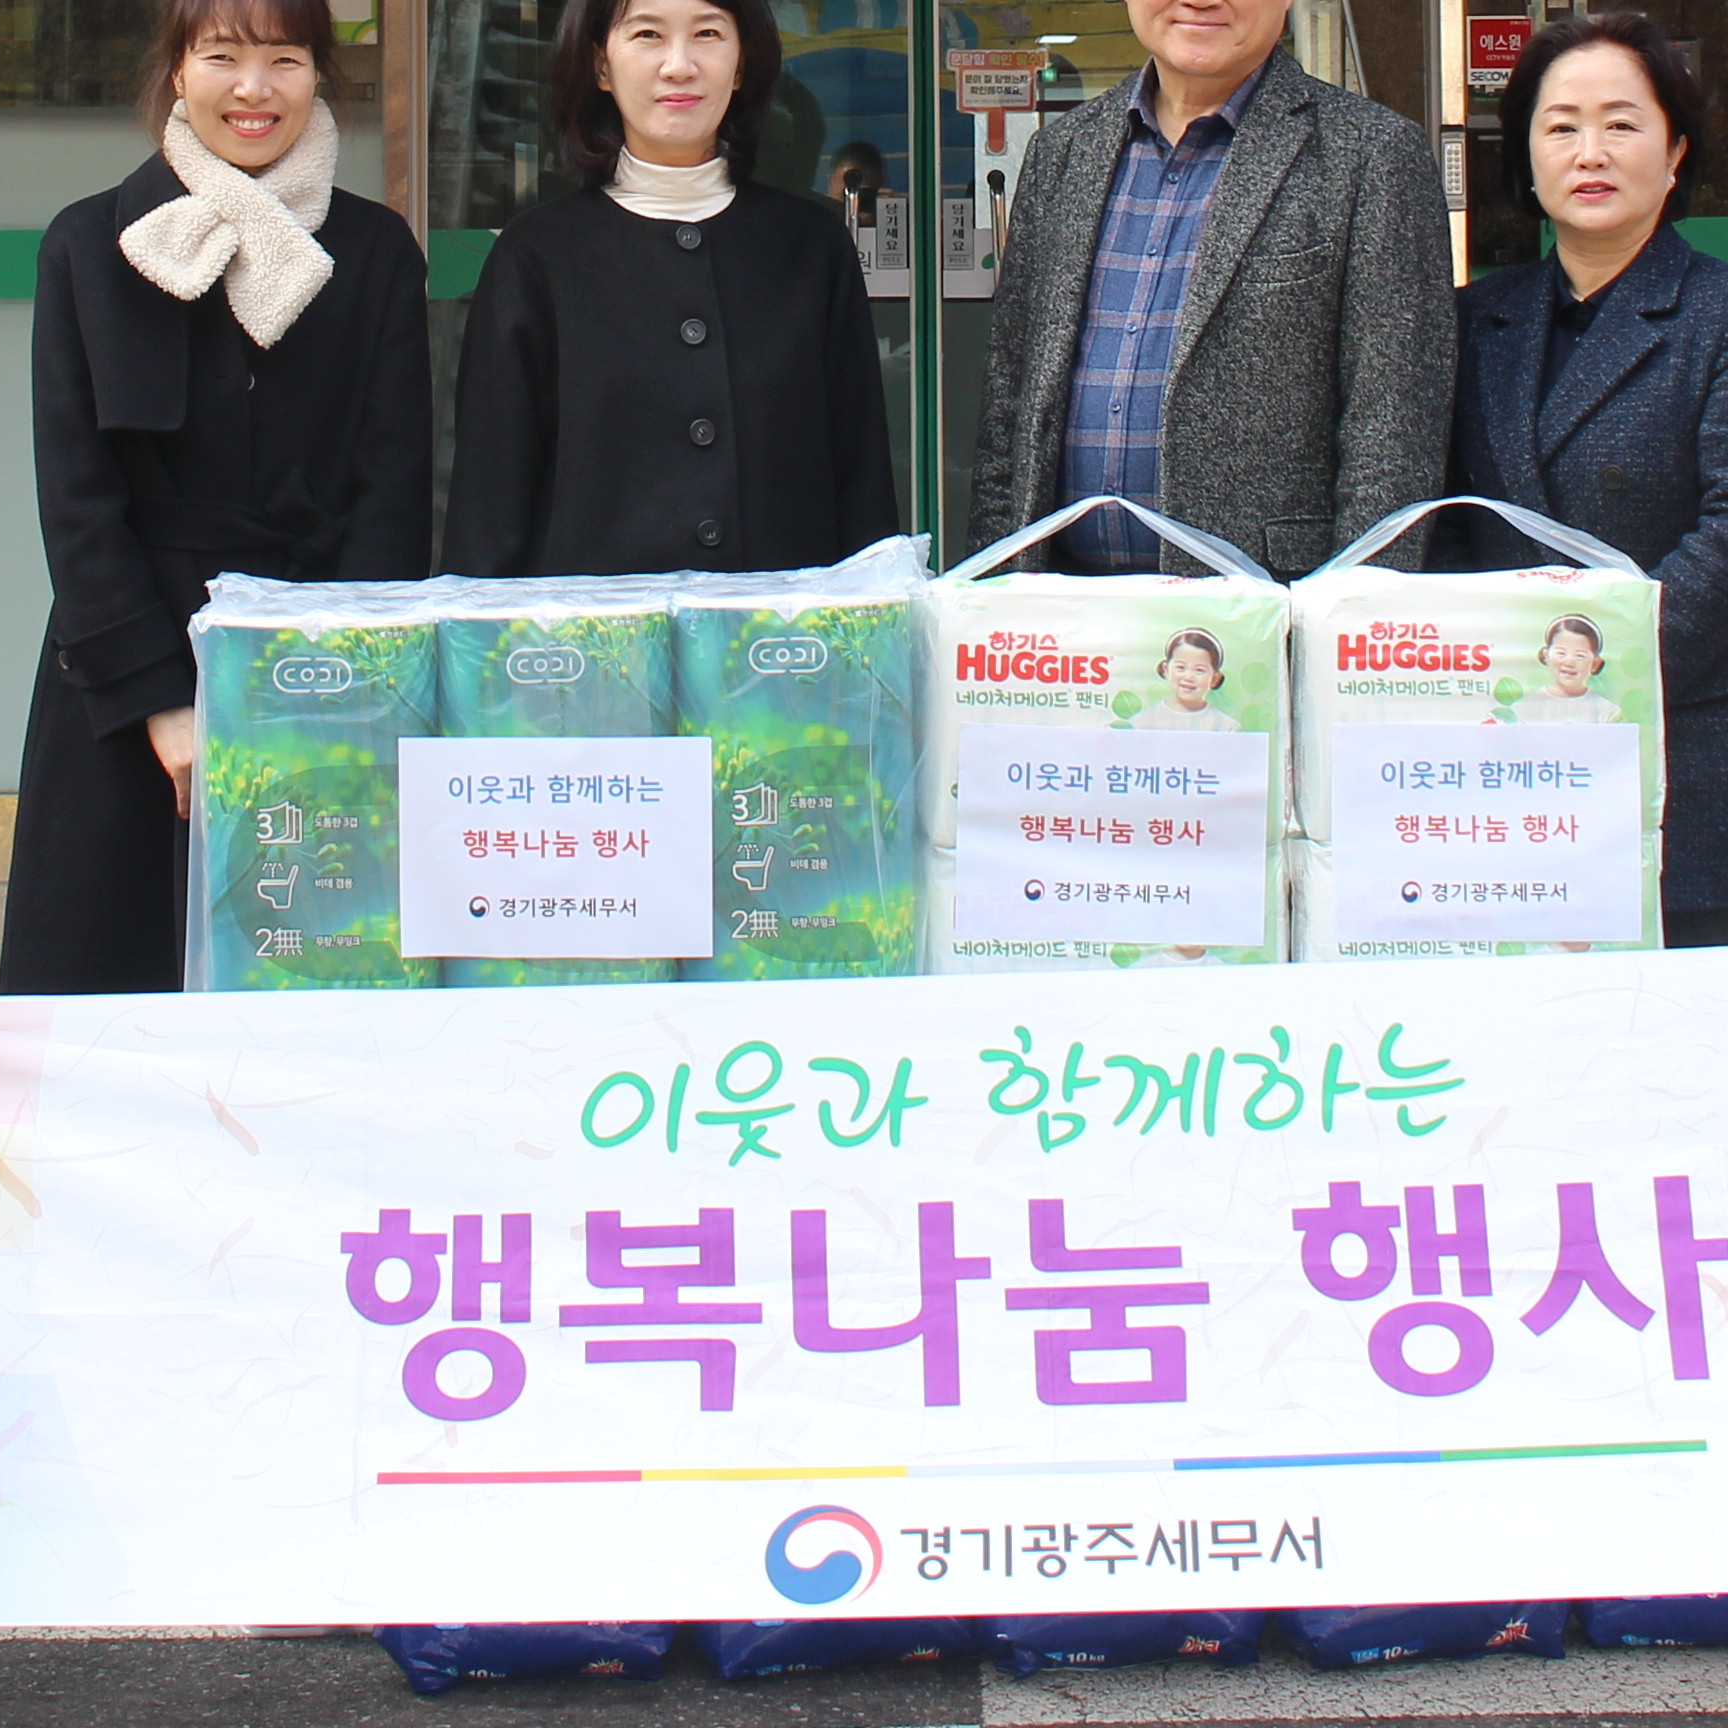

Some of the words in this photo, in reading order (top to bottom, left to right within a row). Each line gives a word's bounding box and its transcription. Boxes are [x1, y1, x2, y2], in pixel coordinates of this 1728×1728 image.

[1479, 34, 1522, 51] 에스원
[885, 202, 898, 251] 당기세요
[952, 203, 965, 252] 당기세요
[988, 630, 1060, 652] 하기스
[1370, 621, 1441, 641] 하기스
[956, 642, 1110, 685] HUGGIES
[1337, 633, 1492, 673] HUGGIES
[955, 689, 1072, 709] 네이처메이드
[1075, 691, 1110, 710] 팬티
[1337, 678, 1454, 697] 네이처메이드
[1457, 678, 1492, 697] 팬티
[448, 775, 536, 806] 이웃과
[547, 774, 665, 806] 함께하는
[1006, 762, 1094, 793] 이웃과
[1105, 766, 1221, 797] 함께하는
[1380, 760, 1467, 791] 이웃과
[1478, 760, 1594, 791] 함께하는
[462, 829, 578, 860] 행복나눔
[591, 829, 651, 860] 행사
[1019, 815, 1135, 845] 행복나눔
[1147, 818, 1206, 847] 행사
[1394, 814, 1510, 844] 행복나눔
[1521, 814, 1581, 844] 행사
[498, 896, 639, 919] 경기광주세무서
[1053, 881, 1193, 906] 경기광주세무서
[1430, 881, 1569, 904] 경기광주세무서
[952, 939, 1068, 958] 네이처메이드
[1073, 940, 1108, 959] 팬티
[580, 1040, 930, 1167] 이웃과
[979, 1022, 1466, 1153] 함께하는
[341, 1198, 1212, 1422] 행복나눔
[900, 1508, 1328, 1584] 경기광주세무서
